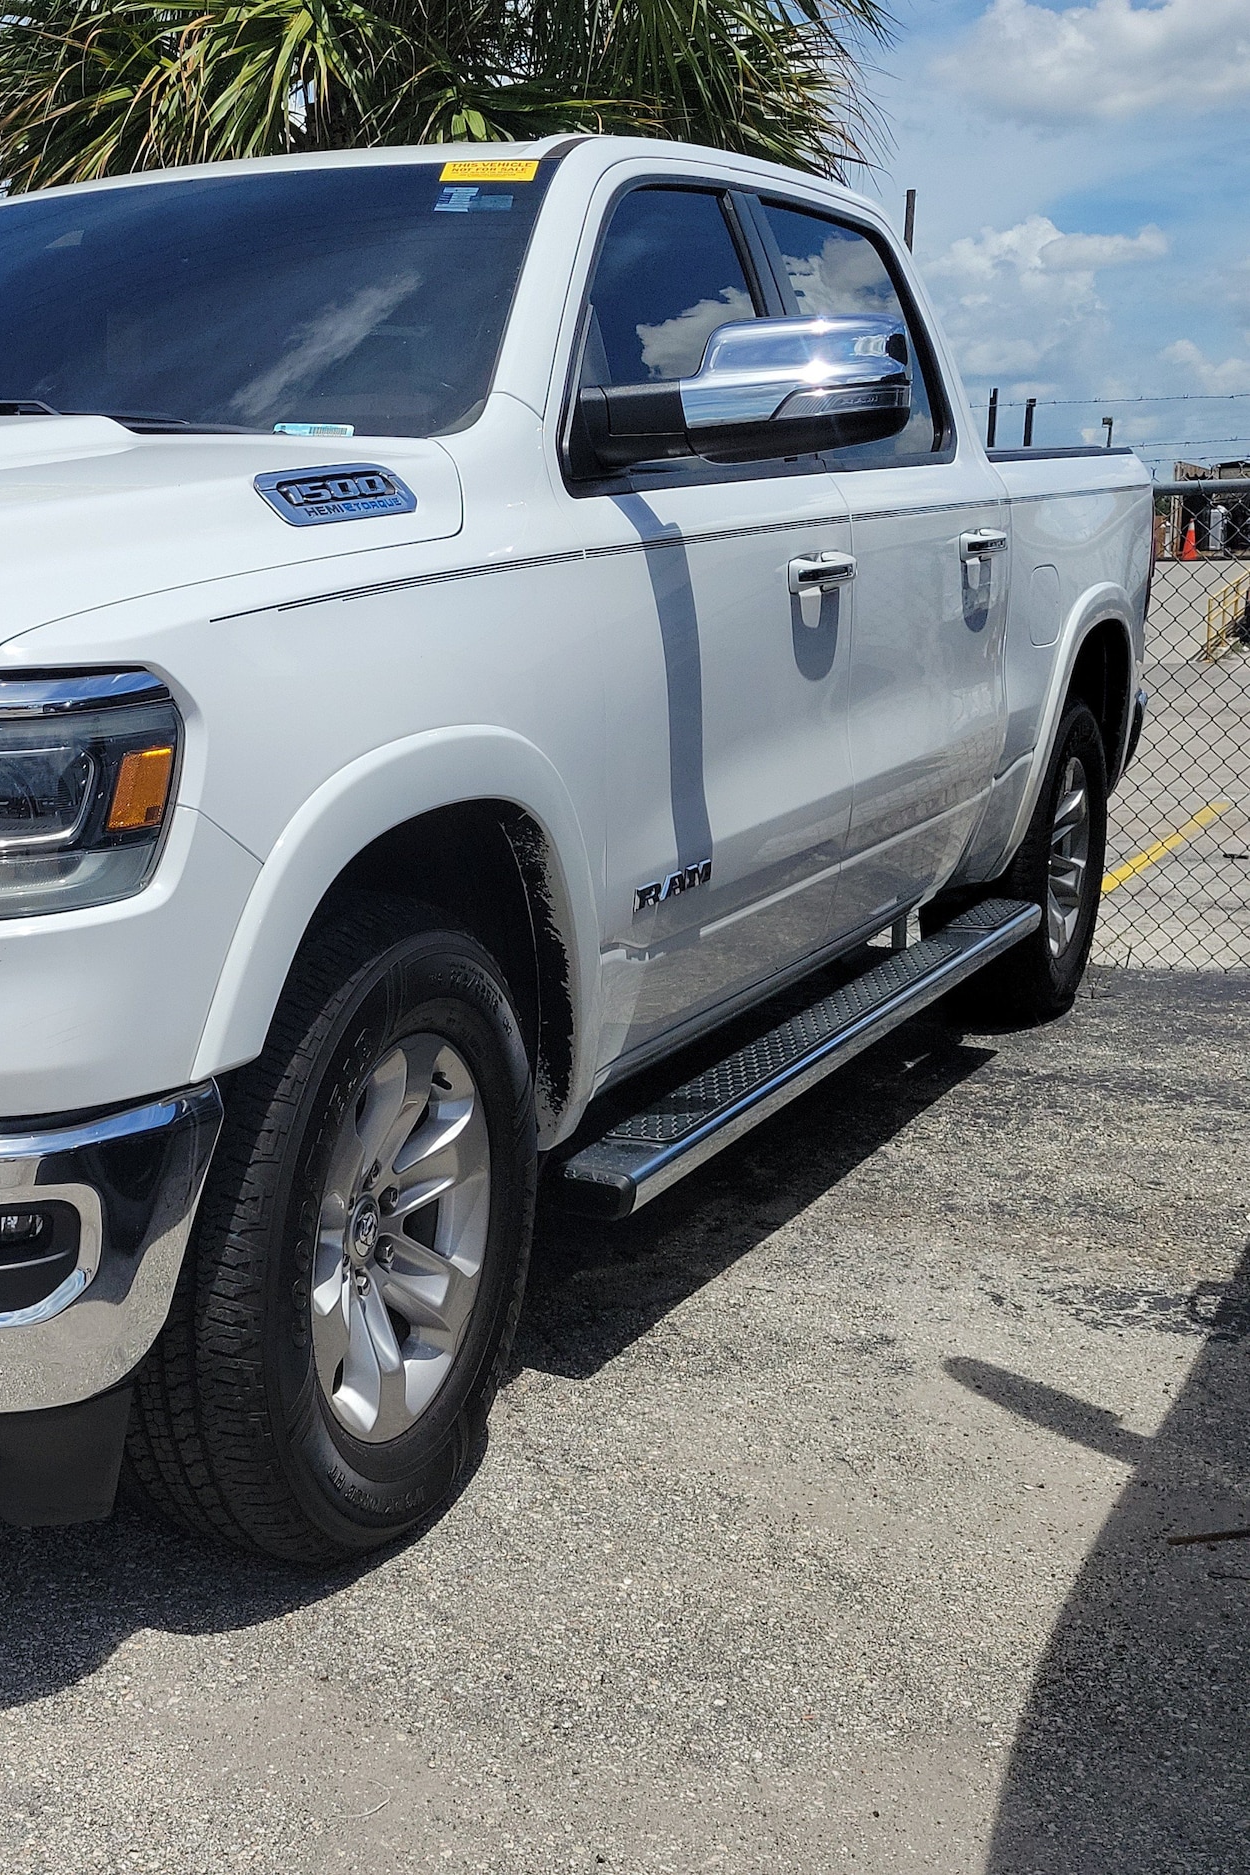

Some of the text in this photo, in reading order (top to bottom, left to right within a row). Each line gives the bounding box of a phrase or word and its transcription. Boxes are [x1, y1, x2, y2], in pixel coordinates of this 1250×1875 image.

[280, 475, 387, 505] 1500
[304, 504, 344, 517] HEMI
[633, 859, 712, 913] RAM
